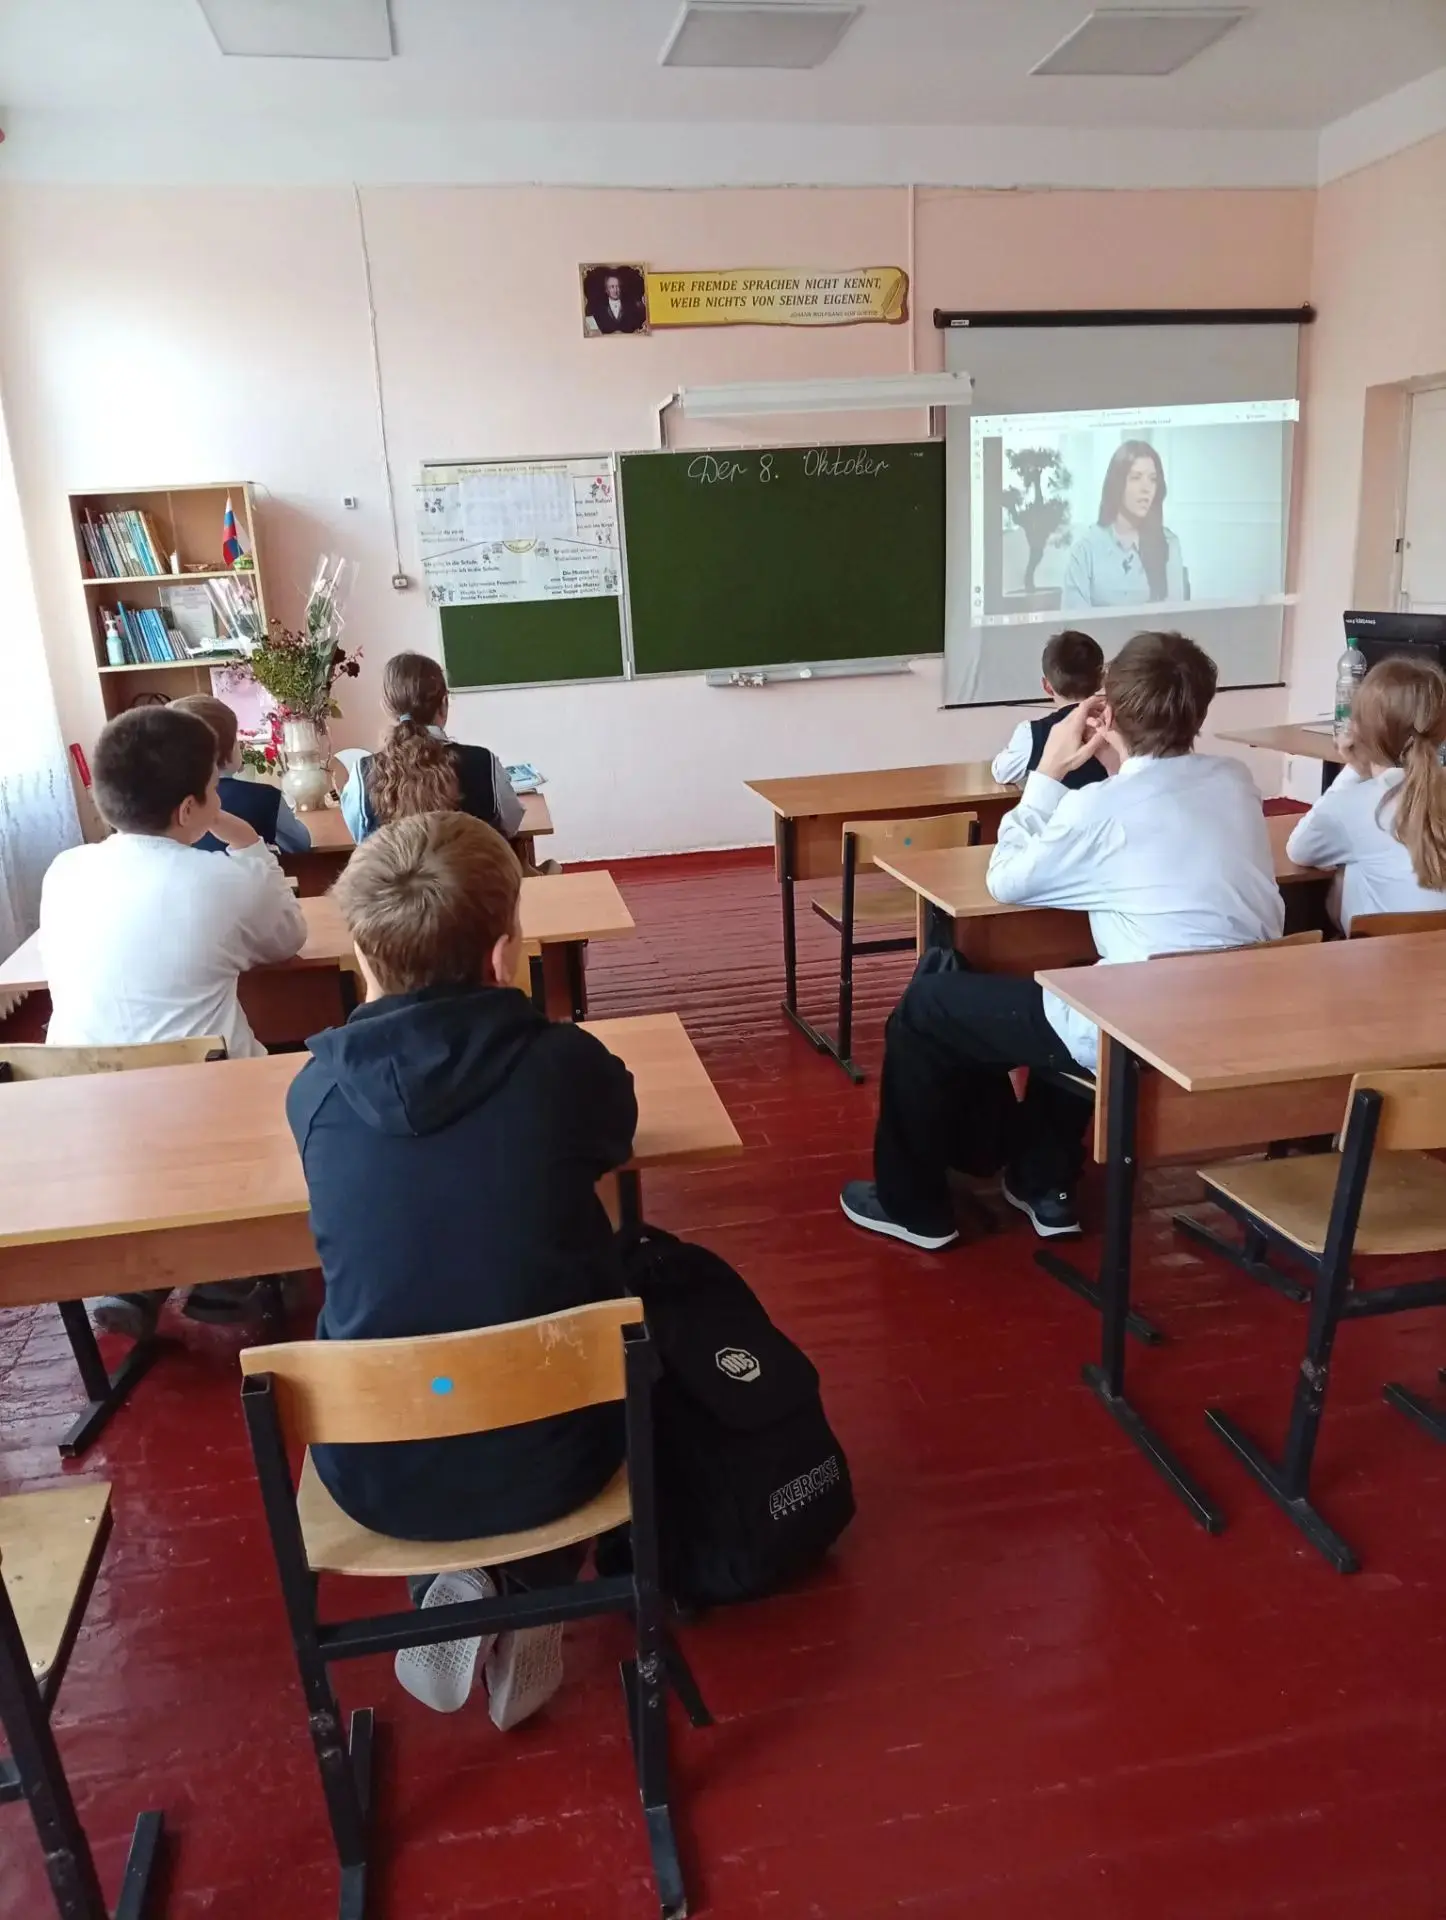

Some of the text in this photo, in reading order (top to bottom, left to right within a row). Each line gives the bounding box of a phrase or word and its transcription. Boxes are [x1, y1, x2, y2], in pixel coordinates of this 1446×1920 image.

[659, 277, 881, 292] WER FREMDE SPRACHEN NICHT KENNT,
[670, 293, 872, 308] WEIB NICHTS VON SEINER EIGENEN.
[688, 448, 889, 484] Der 8. Oktober
[769, 1455, 840, 1514] EXERCISE
